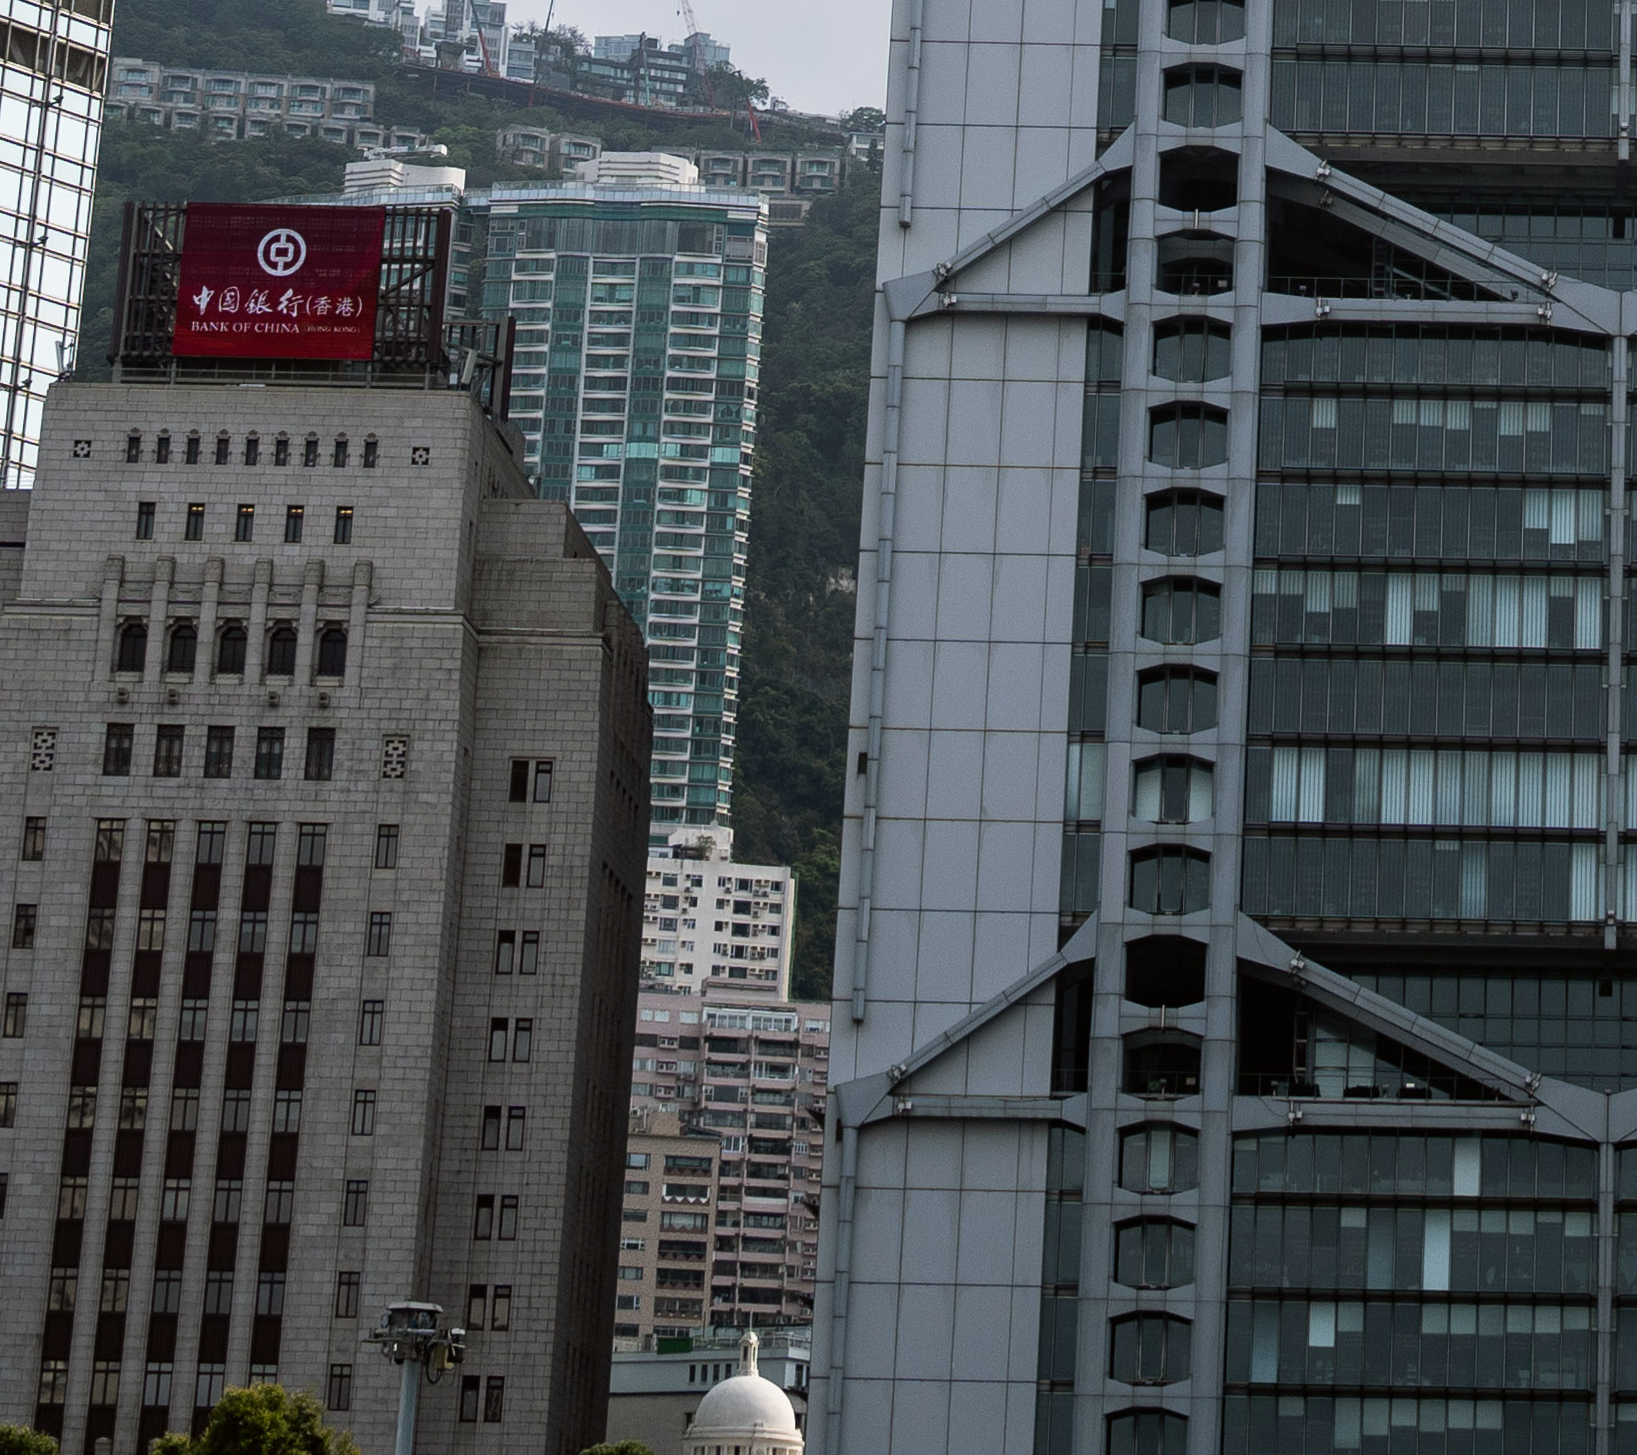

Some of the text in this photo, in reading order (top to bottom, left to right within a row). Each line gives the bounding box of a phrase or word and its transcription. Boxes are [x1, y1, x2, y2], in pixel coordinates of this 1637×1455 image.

[191, 320, 230, 332] BANK
[232, 321, 252, 333] OF
[254, 322, 300, 334] CHINA
